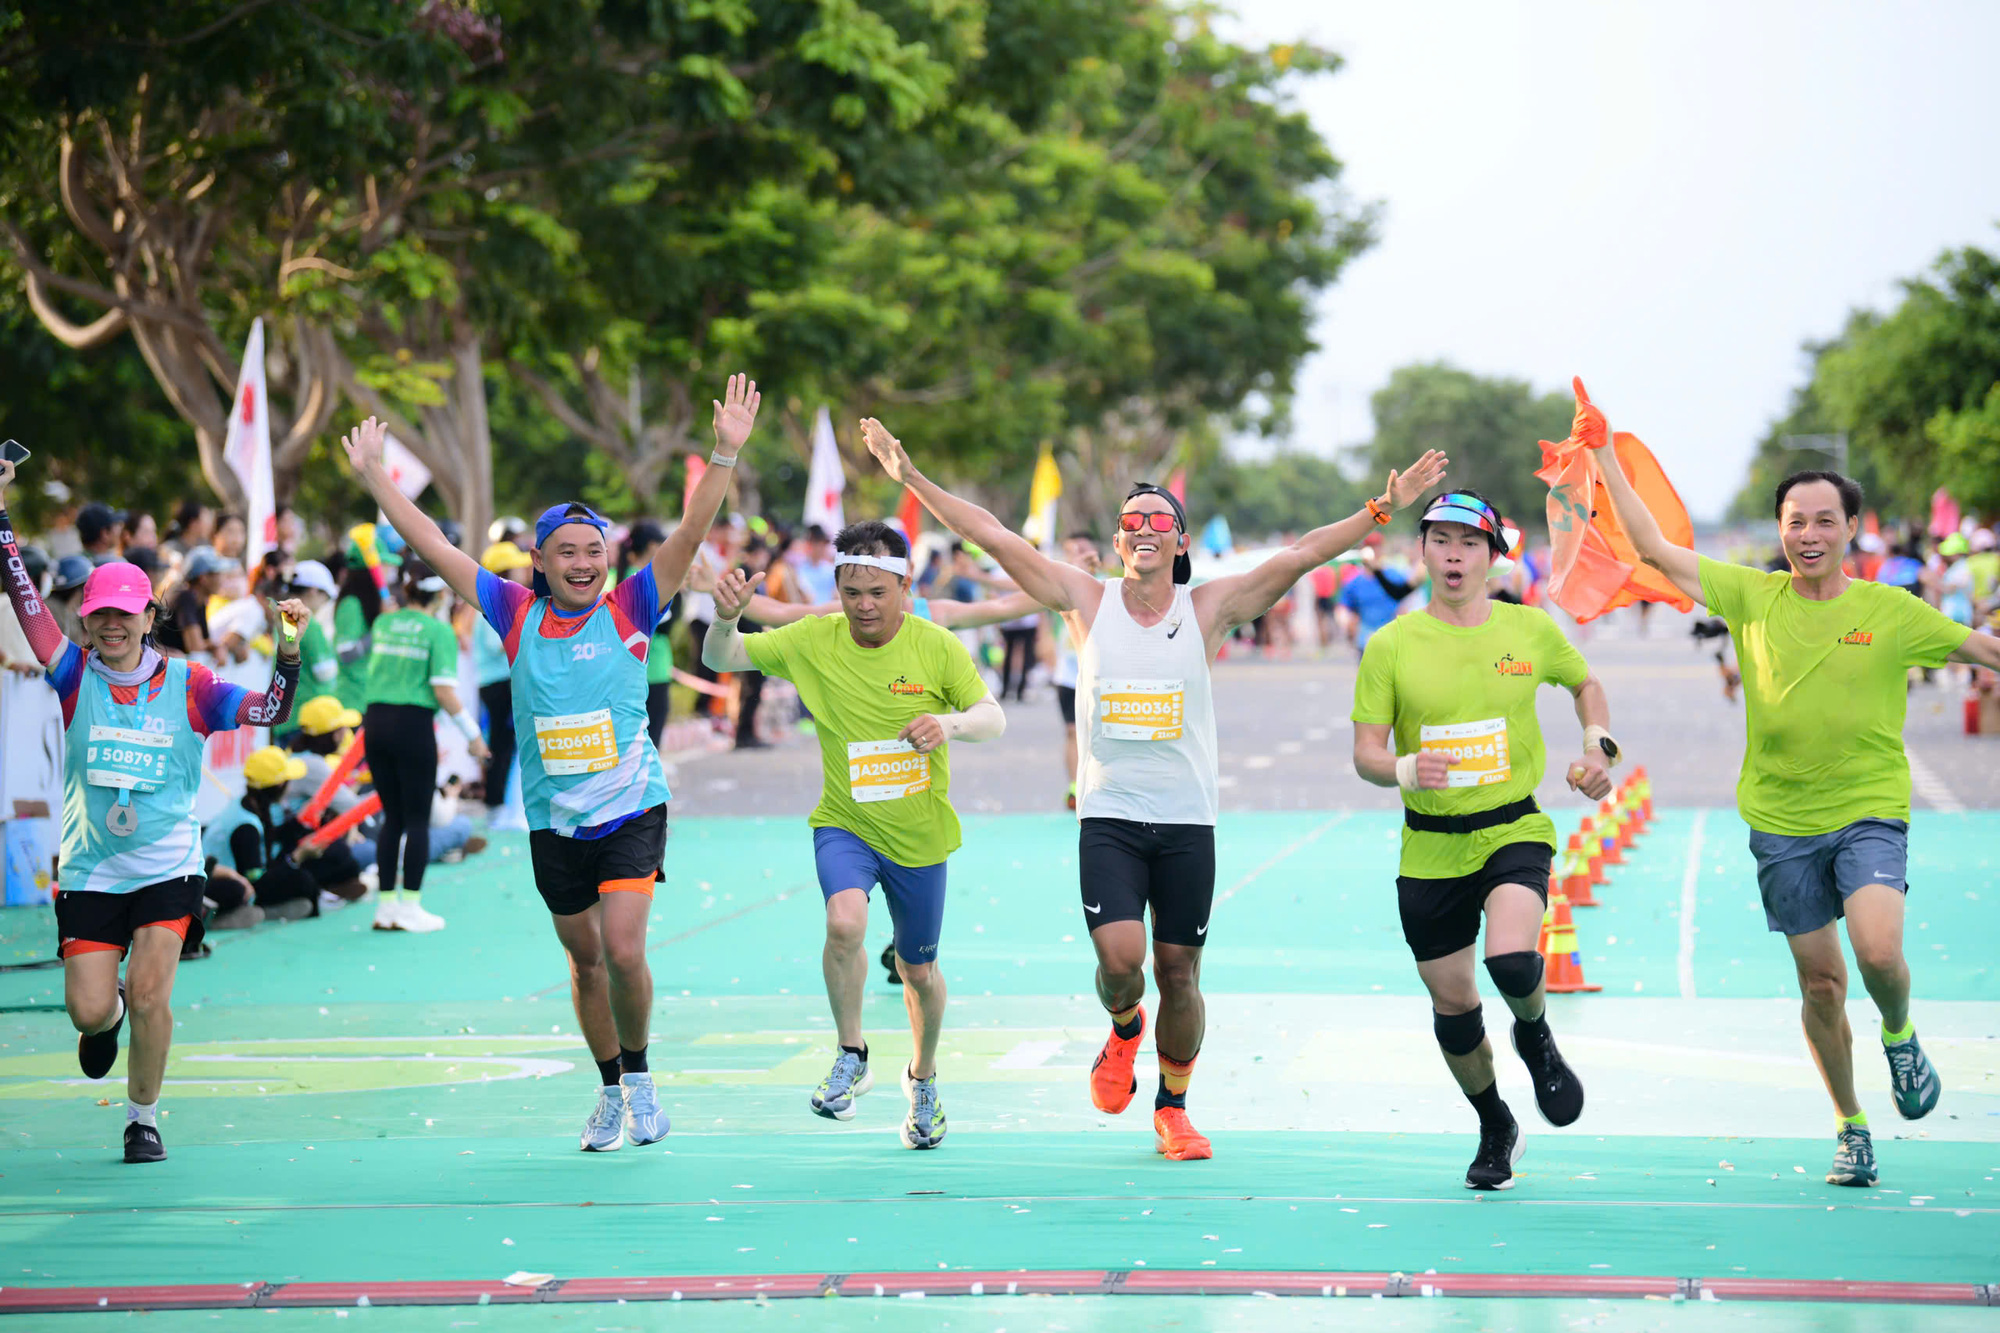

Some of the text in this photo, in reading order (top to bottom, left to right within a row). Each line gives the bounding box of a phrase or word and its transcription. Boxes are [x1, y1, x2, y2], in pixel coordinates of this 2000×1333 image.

[0, 529, 41, 616] SPORTS
[572, 643, 594, 661] 20
[248, 670, 287, 723] SPORTS
[1111, 701, 1172, 715] B20036
[141, 716, 165, 734] 20
[547, 732, 601, 750] C20695
[1157, 731, 1177, 739] 21KM
[102, 747, 153, 767] 50879
[1431, 743, 1495, 760] 0834
[593, 760, 613, 770] 21KM
[861, 757, 920, 776] A20002
